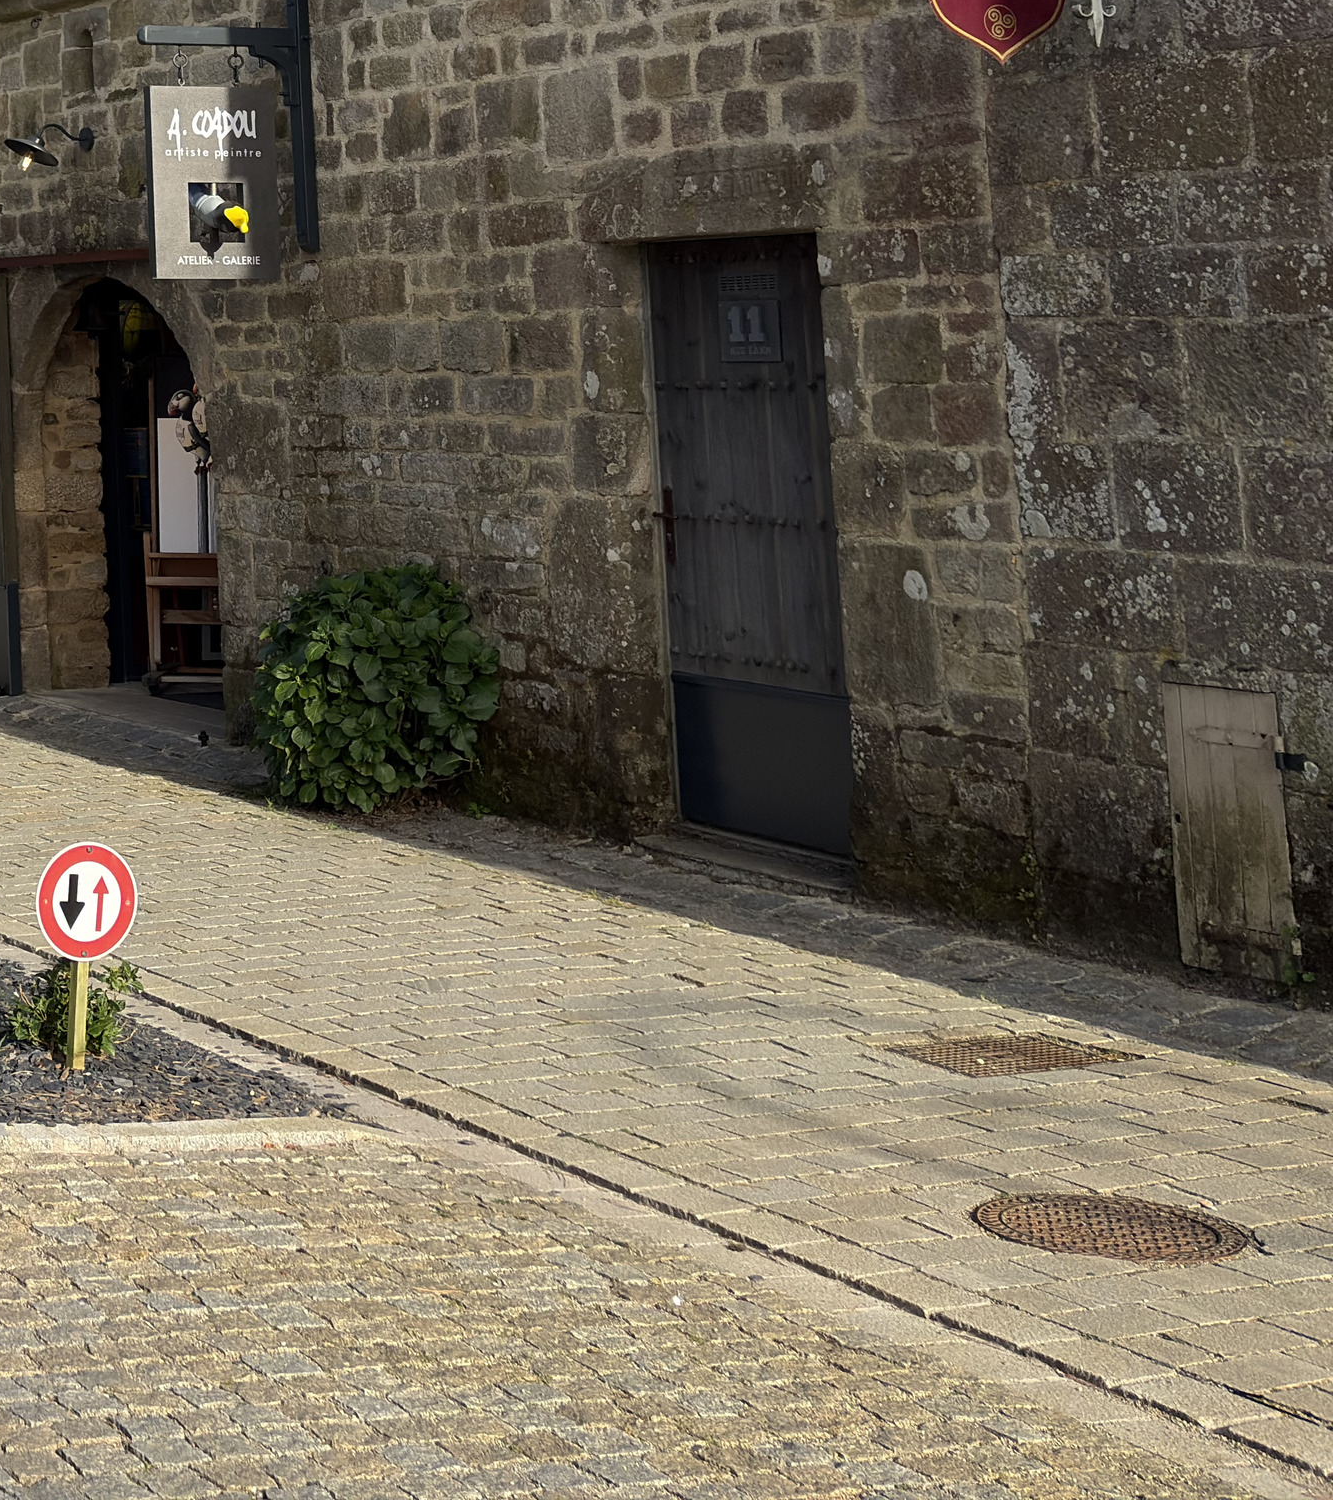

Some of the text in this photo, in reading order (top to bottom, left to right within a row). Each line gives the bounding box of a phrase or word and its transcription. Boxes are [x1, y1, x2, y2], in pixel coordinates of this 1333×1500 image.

[165, 147, 262, 160] artiste peintre
[177, 255, 214, 265] ATELIER
[222, 255, 261, 265] GALERIE
[727, 305, 765, 342] 11
